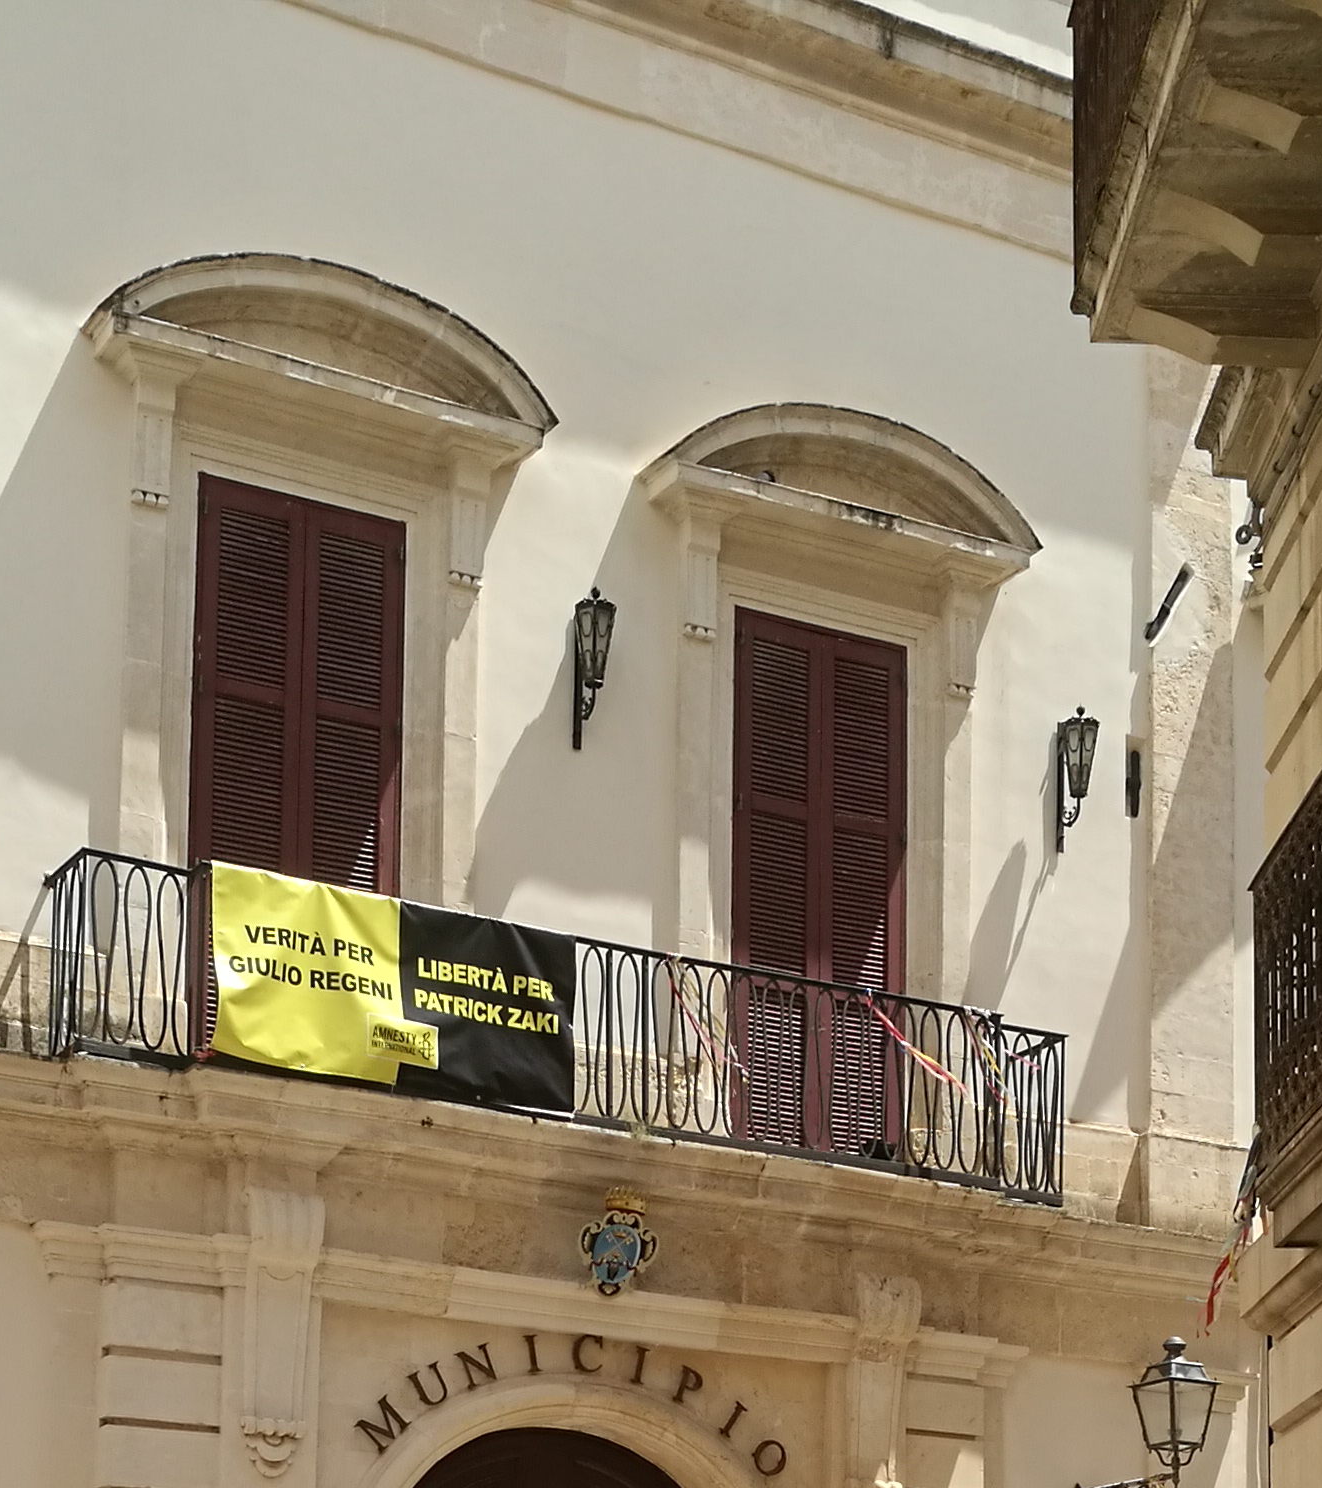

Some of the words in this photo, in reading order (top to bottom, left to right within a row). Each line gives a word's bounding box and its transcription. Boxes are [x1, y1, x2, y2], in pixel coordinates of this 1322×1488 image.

[244, 924, 326, 957] VERITÀ
[333, 938, 375, 966] PER
[229, 955, 303, 986] GIULIO
[310, 969, 393, 1001] REGENI
[417, 956, 506, 994] LIBERTÀ
[512, 975, 555, 1002] PER
[414, 988, 503, 1025] PATRICK
[506, 1006, 560, 1035] ZAKI
[372, 1026, 417, 1046] AMNESTY
[353, 1334, 788, 1477] MUNICIPIO
